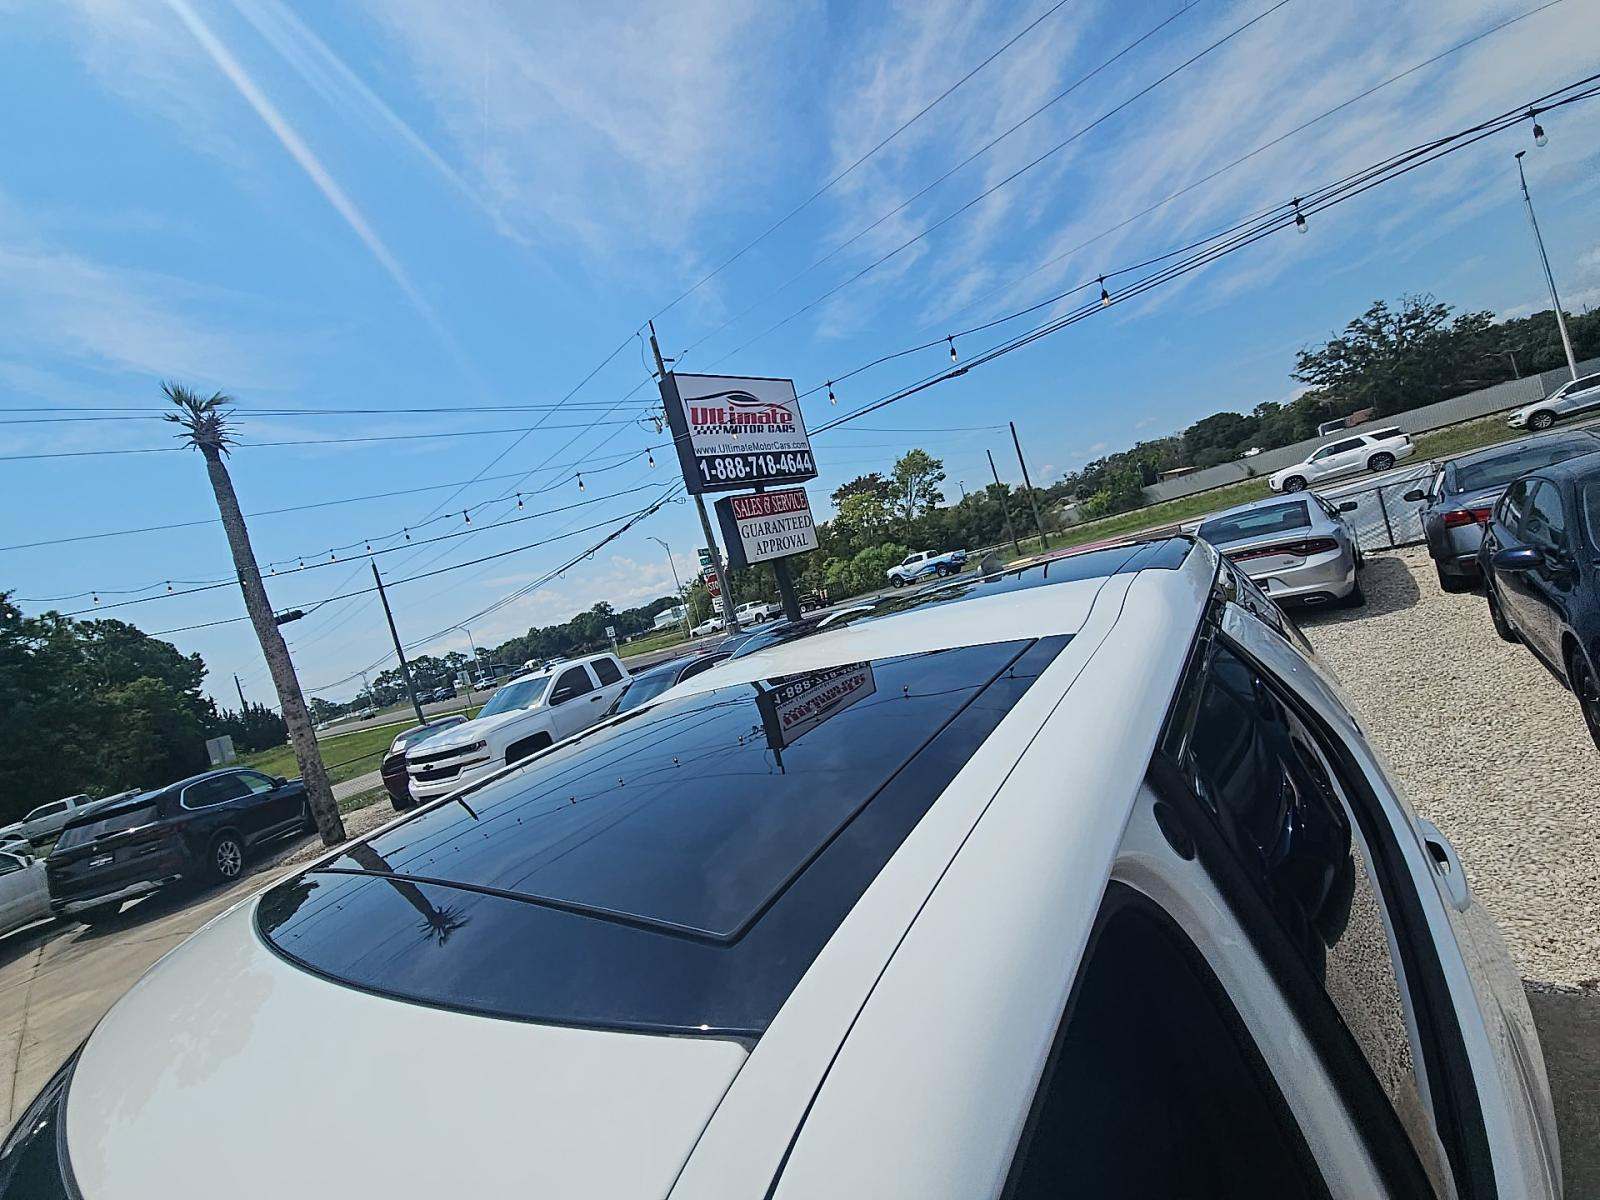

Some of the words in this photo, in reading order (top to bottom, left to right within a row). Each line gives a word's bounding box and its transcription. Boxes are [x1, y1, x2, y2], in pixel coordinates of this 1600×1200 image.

[690, 406, 793, 425] Ultimate
[723, 425, 764, 434] MOTOR
[767, 425, 796, 434] CARS
[695, 441, 807, 455] www.UltimateMotorCars.com
[699, 453, 813, 481] 1-888-718-4644
[734, 497, 763, 518] SALES
[763, 496, 771, 514] &
[771, 492, 806, 512] SERVICE
[741, 515, 812, 539] GUARANTEED
[756, 533, 809, 555] APPROVAL
[708, 581, 720, 592] STO
